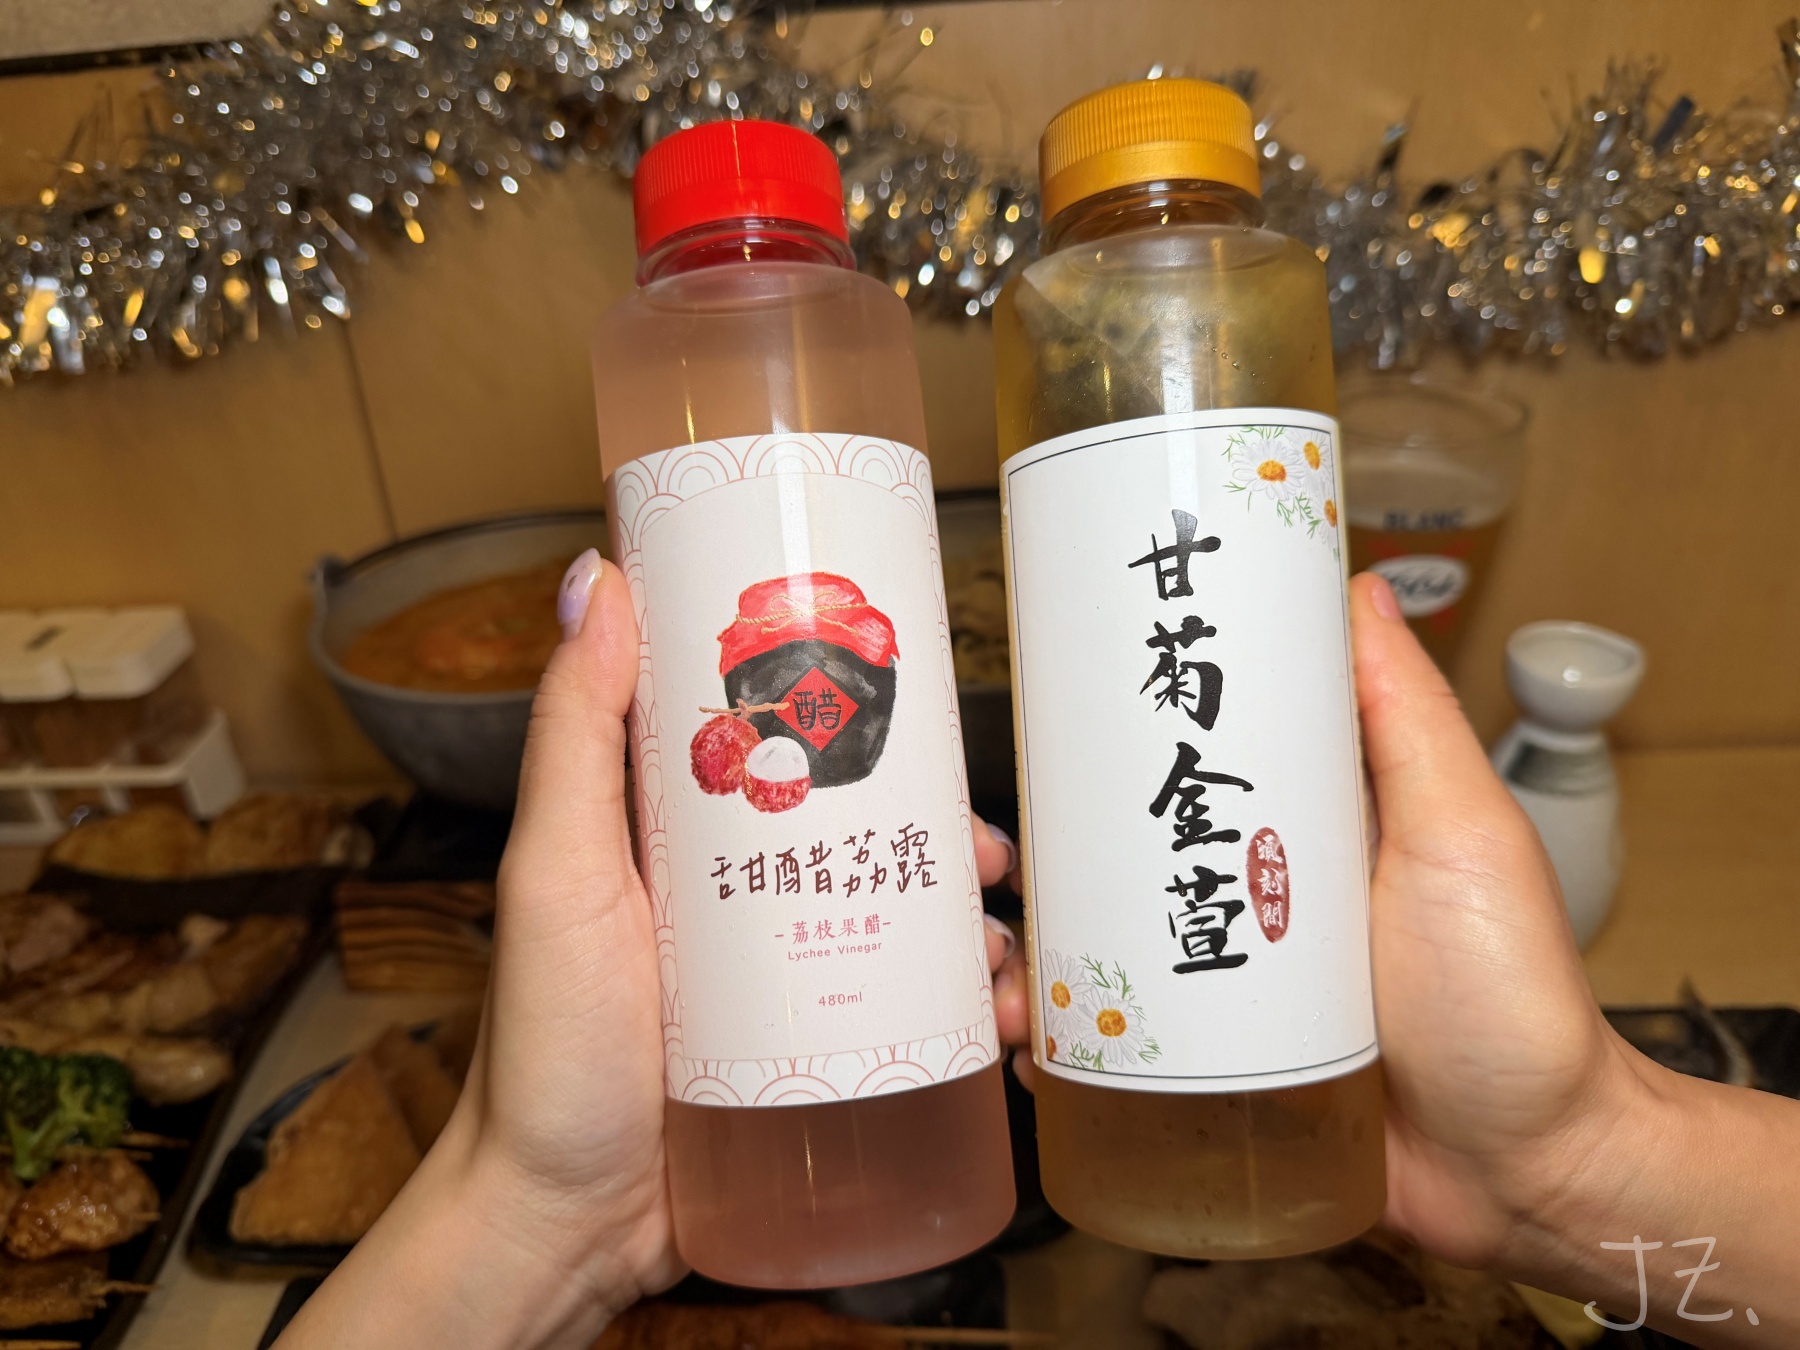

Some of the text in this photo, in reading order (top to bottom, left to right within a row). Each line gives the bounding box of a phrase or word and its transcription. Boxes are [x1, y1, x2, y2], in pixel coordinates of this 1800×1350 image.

[794, 687, 842, 731] 醋
[1127, 508, 1254, 975] 甘菊金萱
[787, 940, 883, 962] Lychee Vinegar
[818, 991, 863, 1007] 480ml
